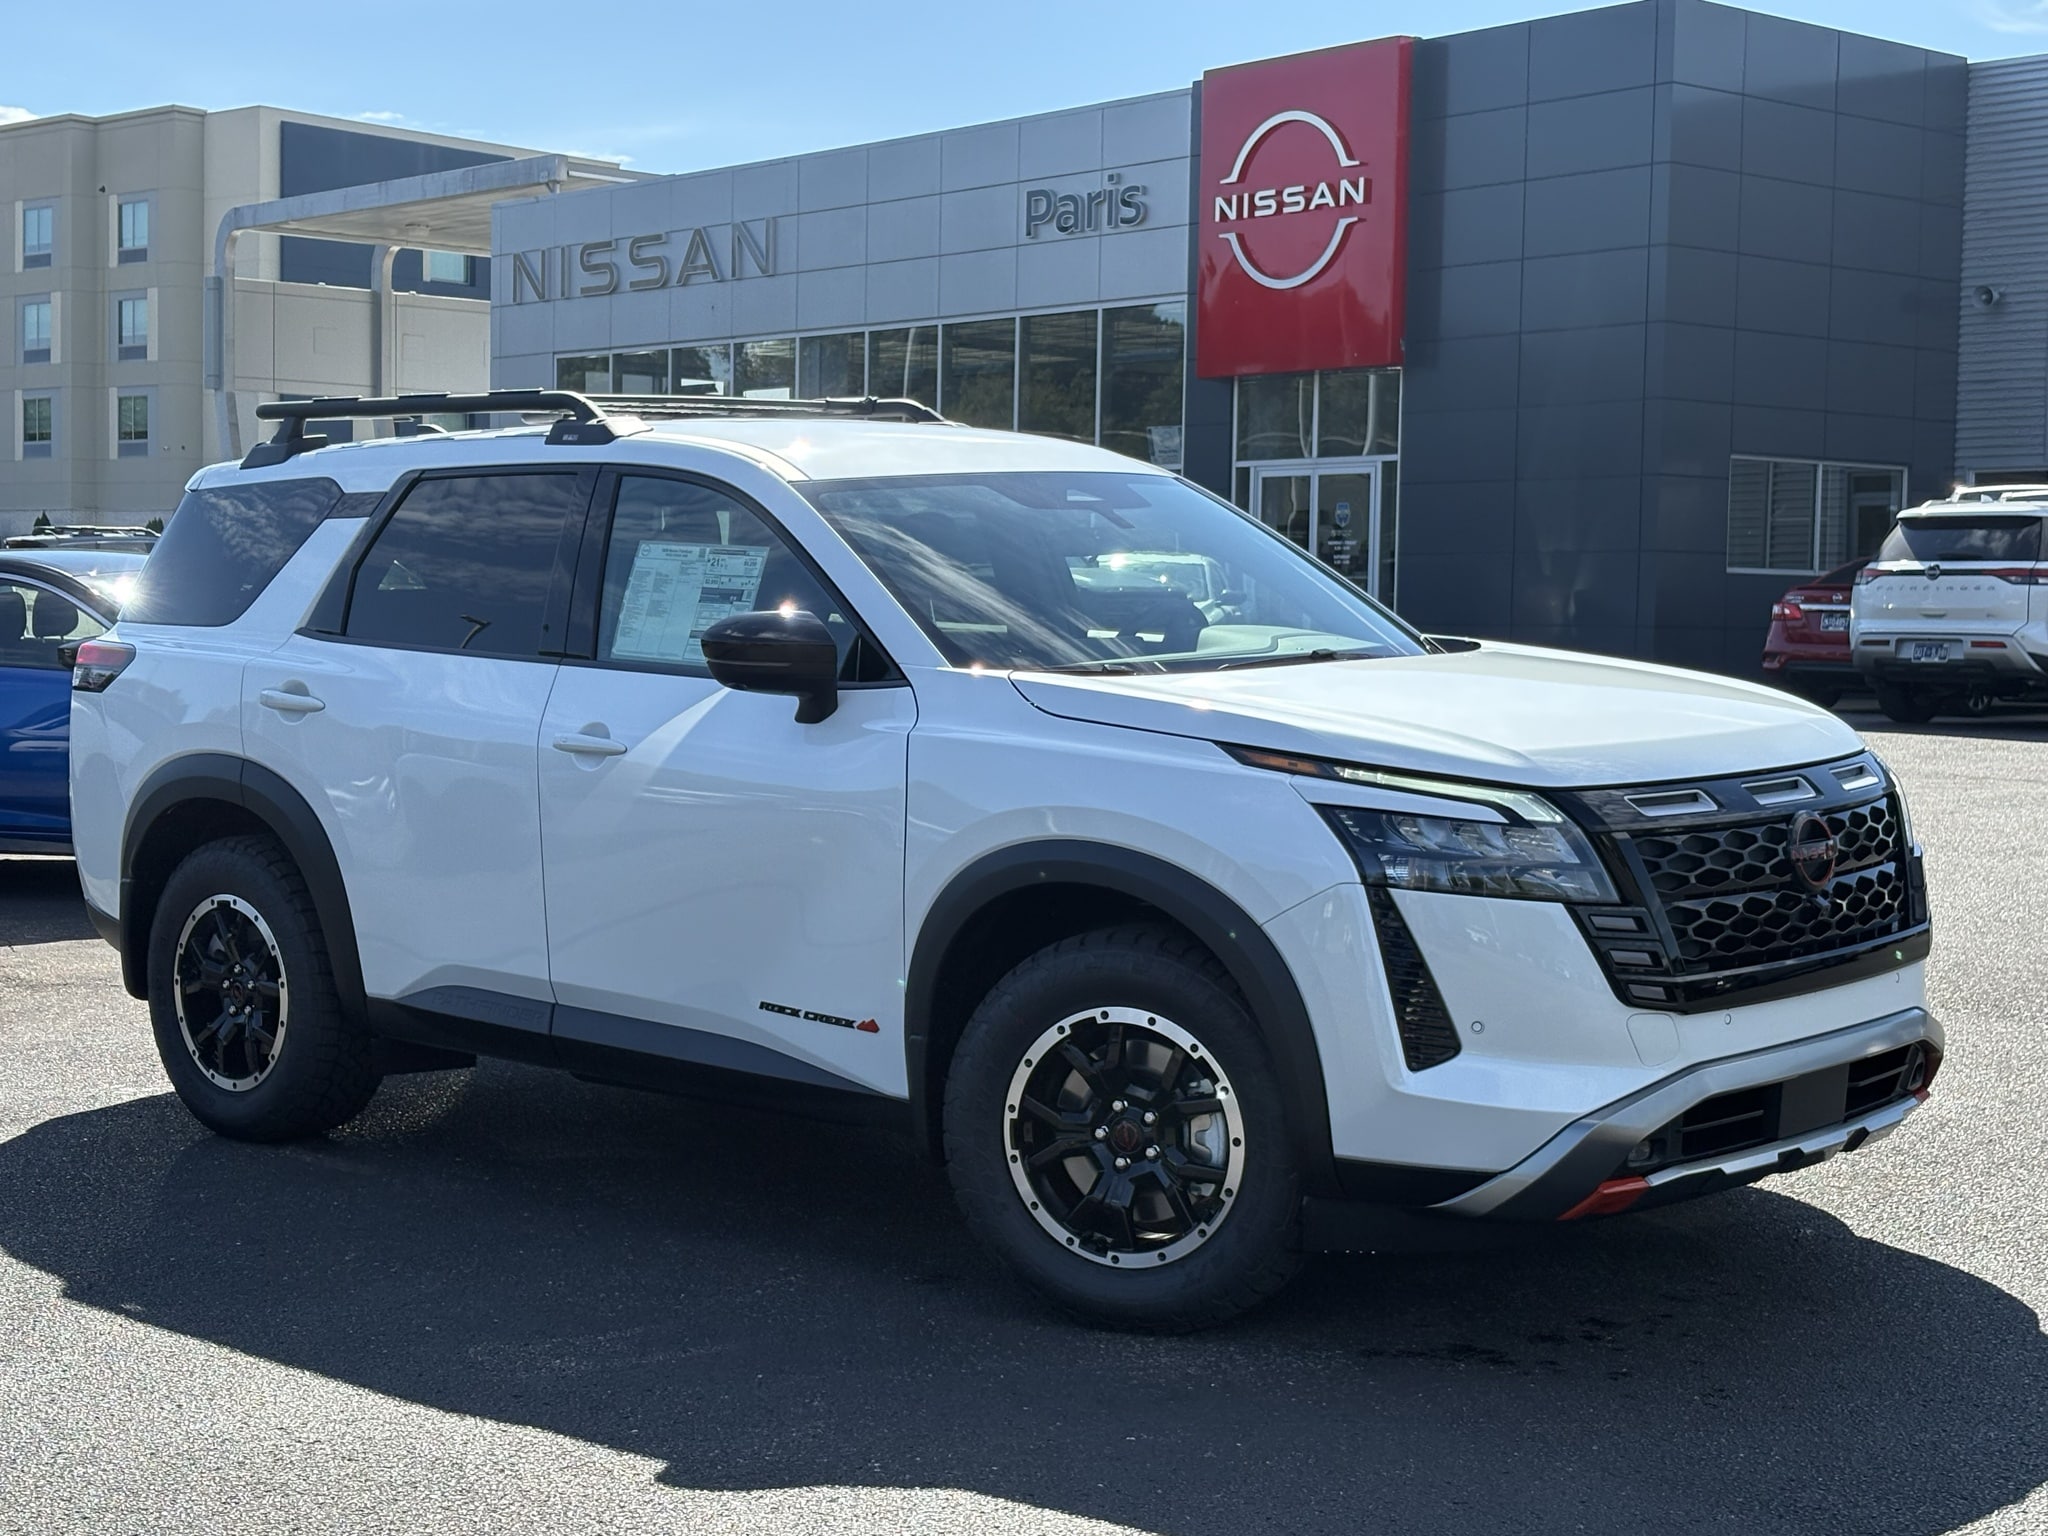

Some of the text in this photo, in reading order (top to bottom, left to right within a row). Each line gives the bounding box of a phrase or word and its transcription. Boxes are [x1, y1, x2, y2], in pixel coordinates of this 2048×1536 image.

[1025, 173, 1144, 237] Paris
[1214, 177, 1365, 222] NISSAN
[511, 216, 776, 305] NISSAN
[758, 1001, 857, 1029] ROCK CREEK
